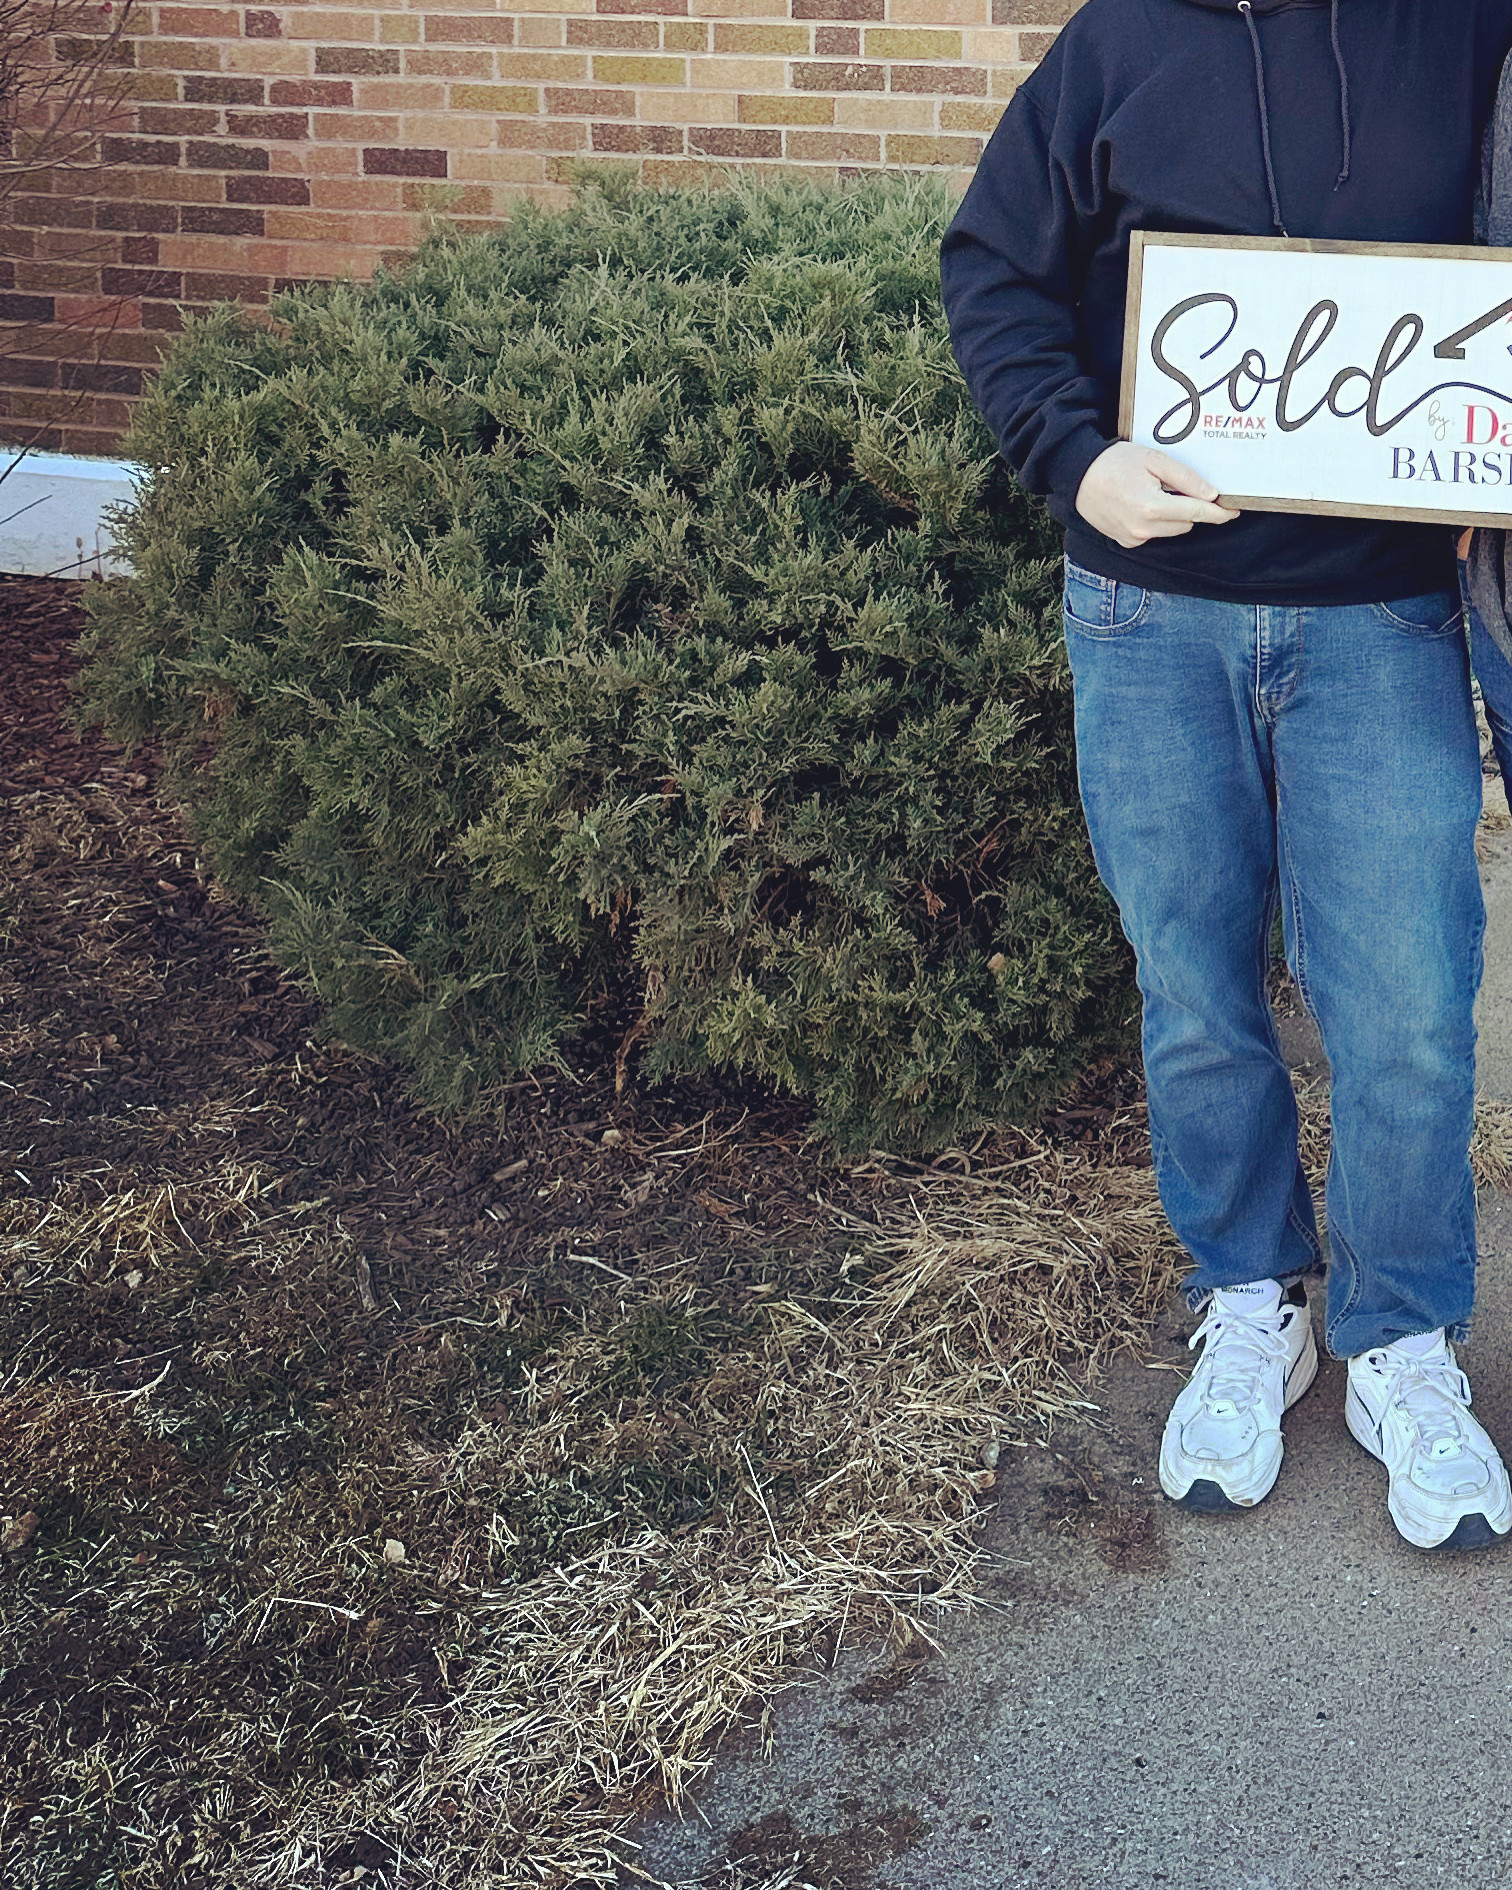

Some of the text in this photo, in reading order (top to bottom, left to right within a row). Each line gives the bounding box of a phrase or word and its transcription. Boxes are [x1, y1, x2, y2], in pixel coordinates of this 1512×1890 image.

[1150, 292, 1424, 445] Sold
[1203, 415, 1266, 430] RE/MAX
[1203, 430, 1267, 441] TOTAL REALTY
